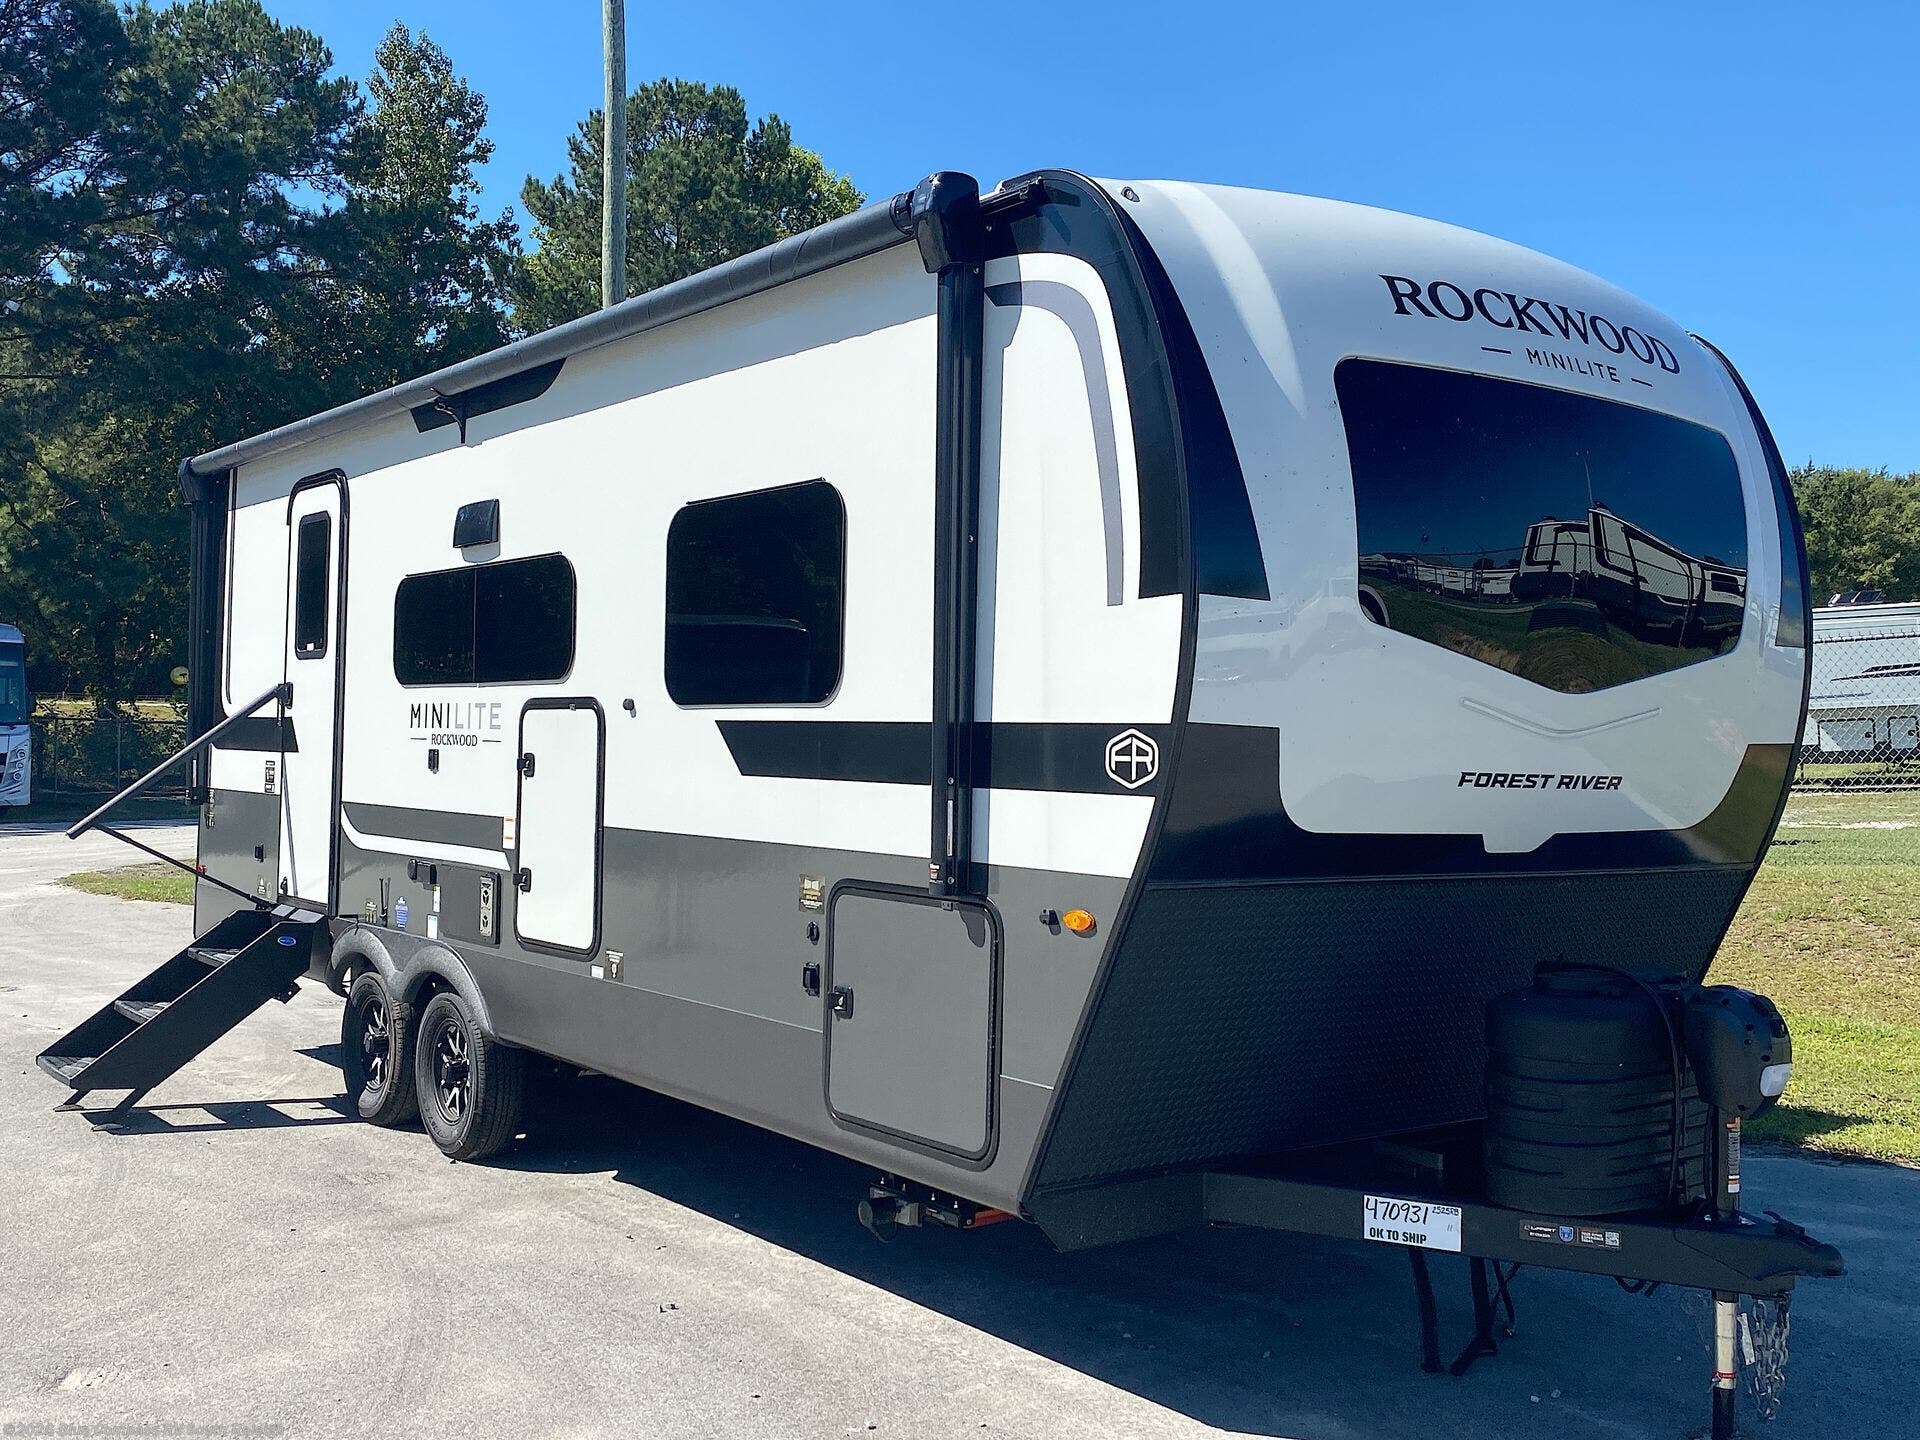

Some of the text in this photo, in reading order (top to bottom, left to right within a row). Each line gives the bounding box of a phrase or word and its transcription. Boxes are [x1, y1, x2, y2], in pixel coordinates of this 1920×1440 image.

[1378, 273, 1681, 375] ROCKWOOD
[1526, 347, 1621, 382] MINILITE
[410, 702, 502, 730] MINILITE
[431, 733, 478, 747] ROCKWOOD
[1457, 771, 1623, 790] FOREST RIVER
[1365, 1197, 1429, 1225] 470931
[1369, 1227, 1427, 1245] OK TO SHIP
